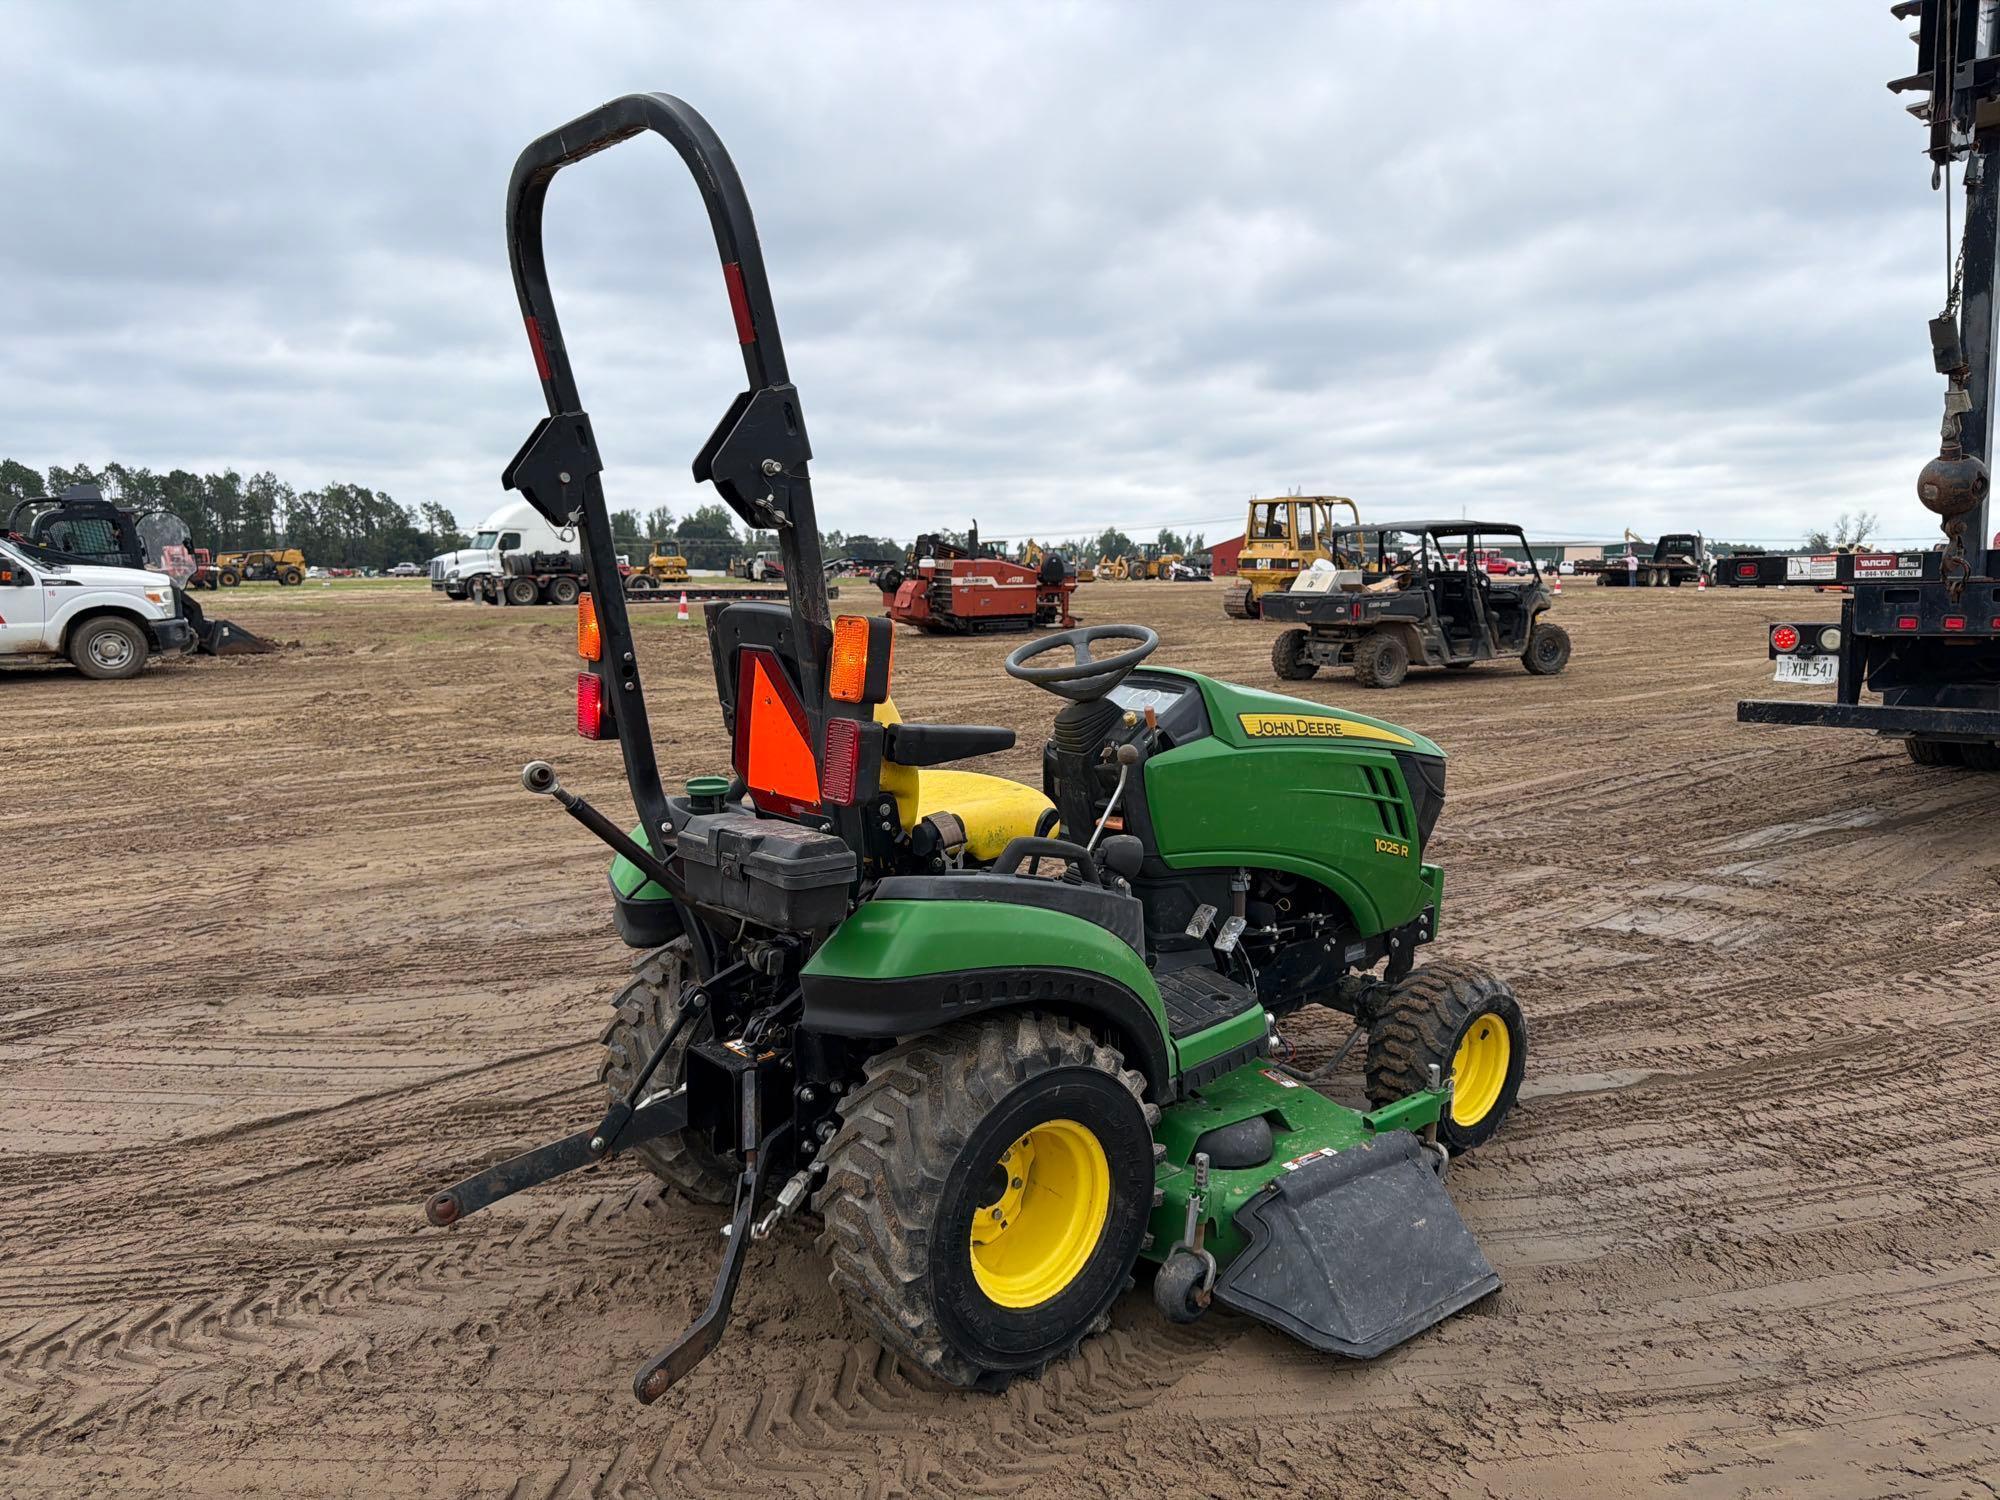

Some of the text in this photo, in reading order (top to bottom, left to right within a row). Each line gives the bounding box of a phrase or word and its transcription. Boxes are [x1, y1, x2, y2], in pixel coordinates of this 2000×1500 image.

[1256, 558, 1271, 570] CAT
[1860, 559, 1891, 567] YANCEY
[1791, 662, 1833, 677] XHL541
[1255, 719, 1343, 735] JOHN DEERE
